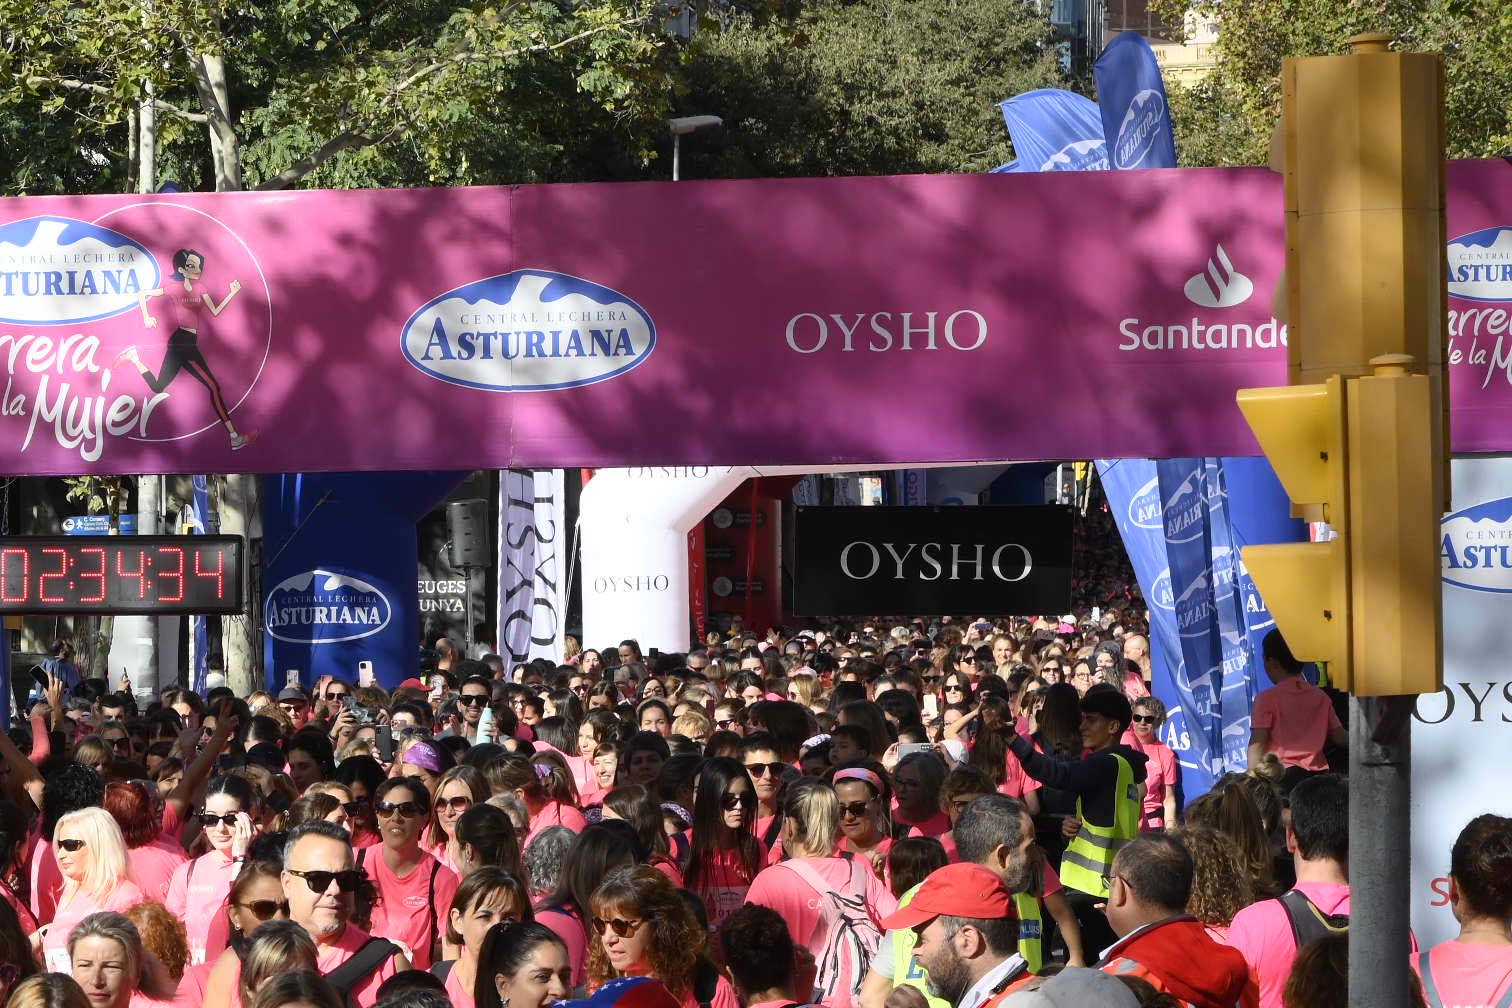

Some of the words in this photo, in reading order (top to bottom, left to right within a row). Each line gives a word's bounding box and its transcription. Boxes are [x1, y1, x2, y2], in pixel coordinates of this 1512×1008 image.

[63, 252, 136, 263] LECHERA
[460, 311, 538, 324] CENTRAL
[546, 310, 628, 323] LECHERA
[786, 308, 988, 353] OYSHO
[421, 316, 636, 361] ASTURIANA
[2, 375, 26, 416] la
[20, 368, 172, 462] Mujer
[0, 546, 224, 603] 02:34:34
[839, 541, 1034, 583] OYSHO
[594, 574, 670, 594] OYSHO
[269, 599, 381, 628] ASTURIANA
[281, 595, 325, 604] CENTRAL
[328, 594, 377, 603] LECHERA
[418, 599, 465, 612] UNYA
